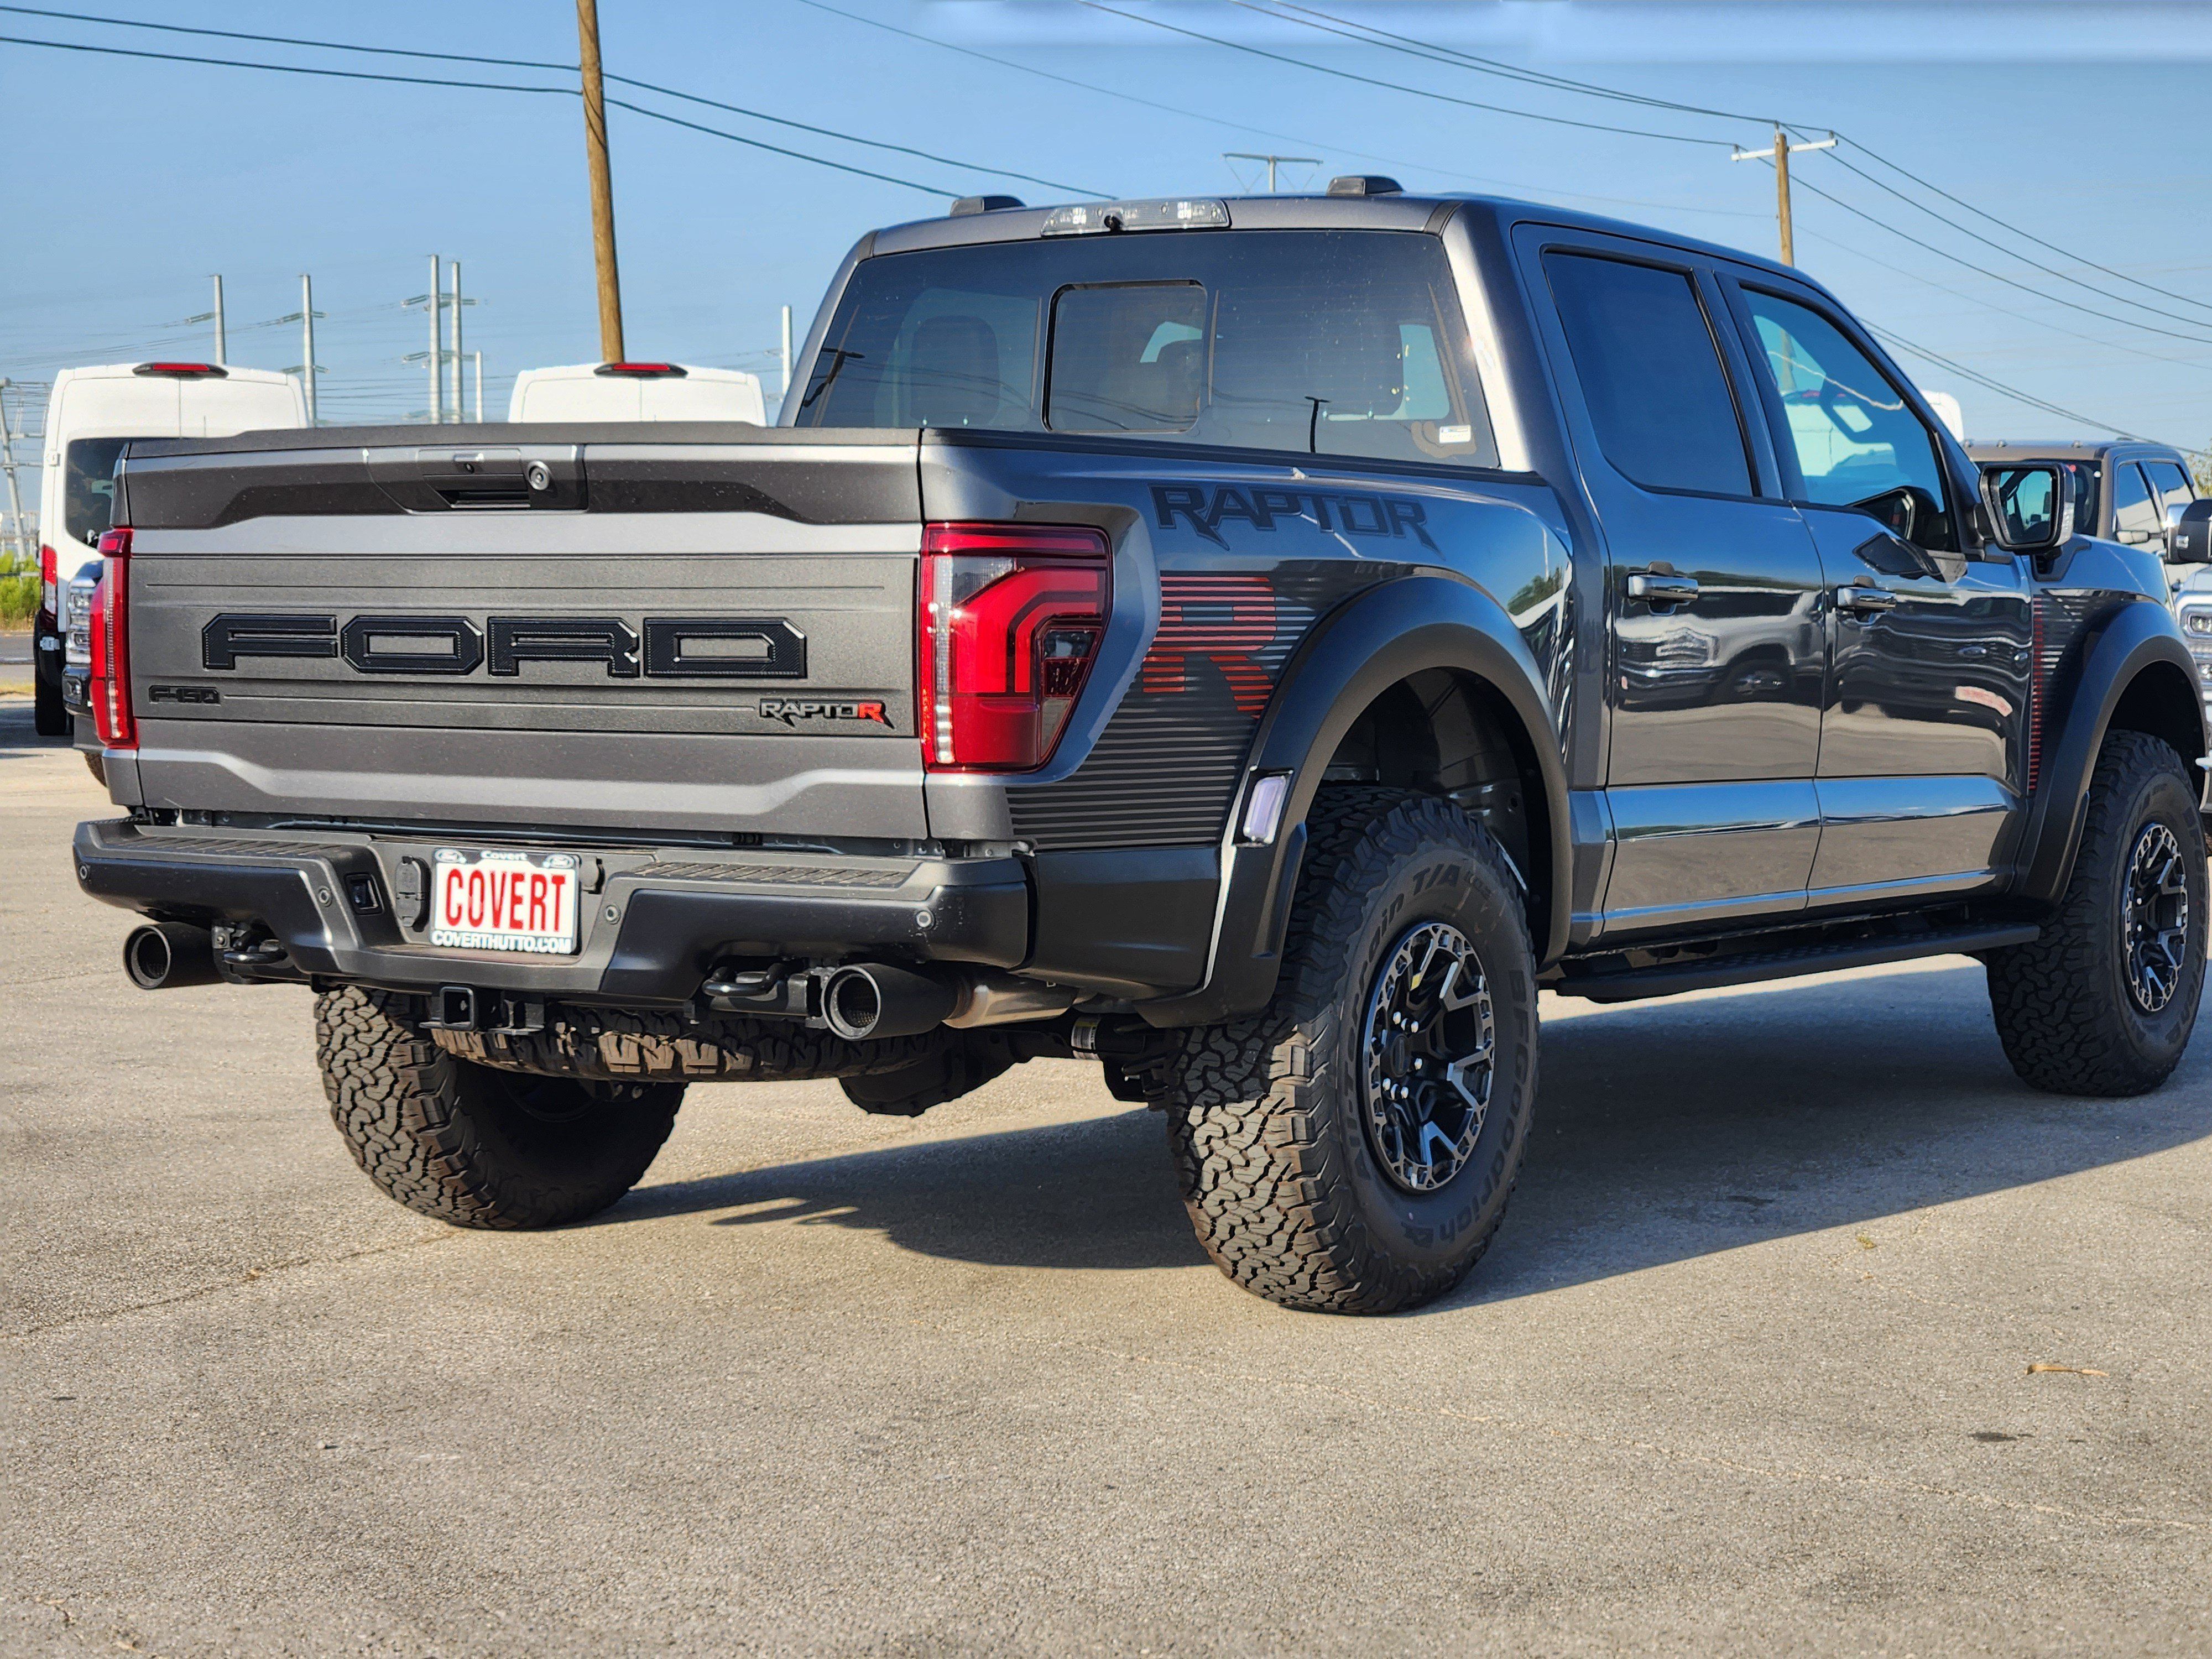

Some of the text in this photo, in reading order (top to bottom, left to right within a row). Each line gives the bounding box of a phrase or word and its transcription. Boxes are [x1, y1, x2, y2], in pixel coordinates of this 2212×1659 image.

[1148, 485, 1446, 561] RAPTOR
[202, 613, 808, 679] FORD
[760, 698, 895, 729] RAPTOR
[445, 868, 566, 932] COVERT
[431, 930, 573, 954] COVERTHUTTO.COM
